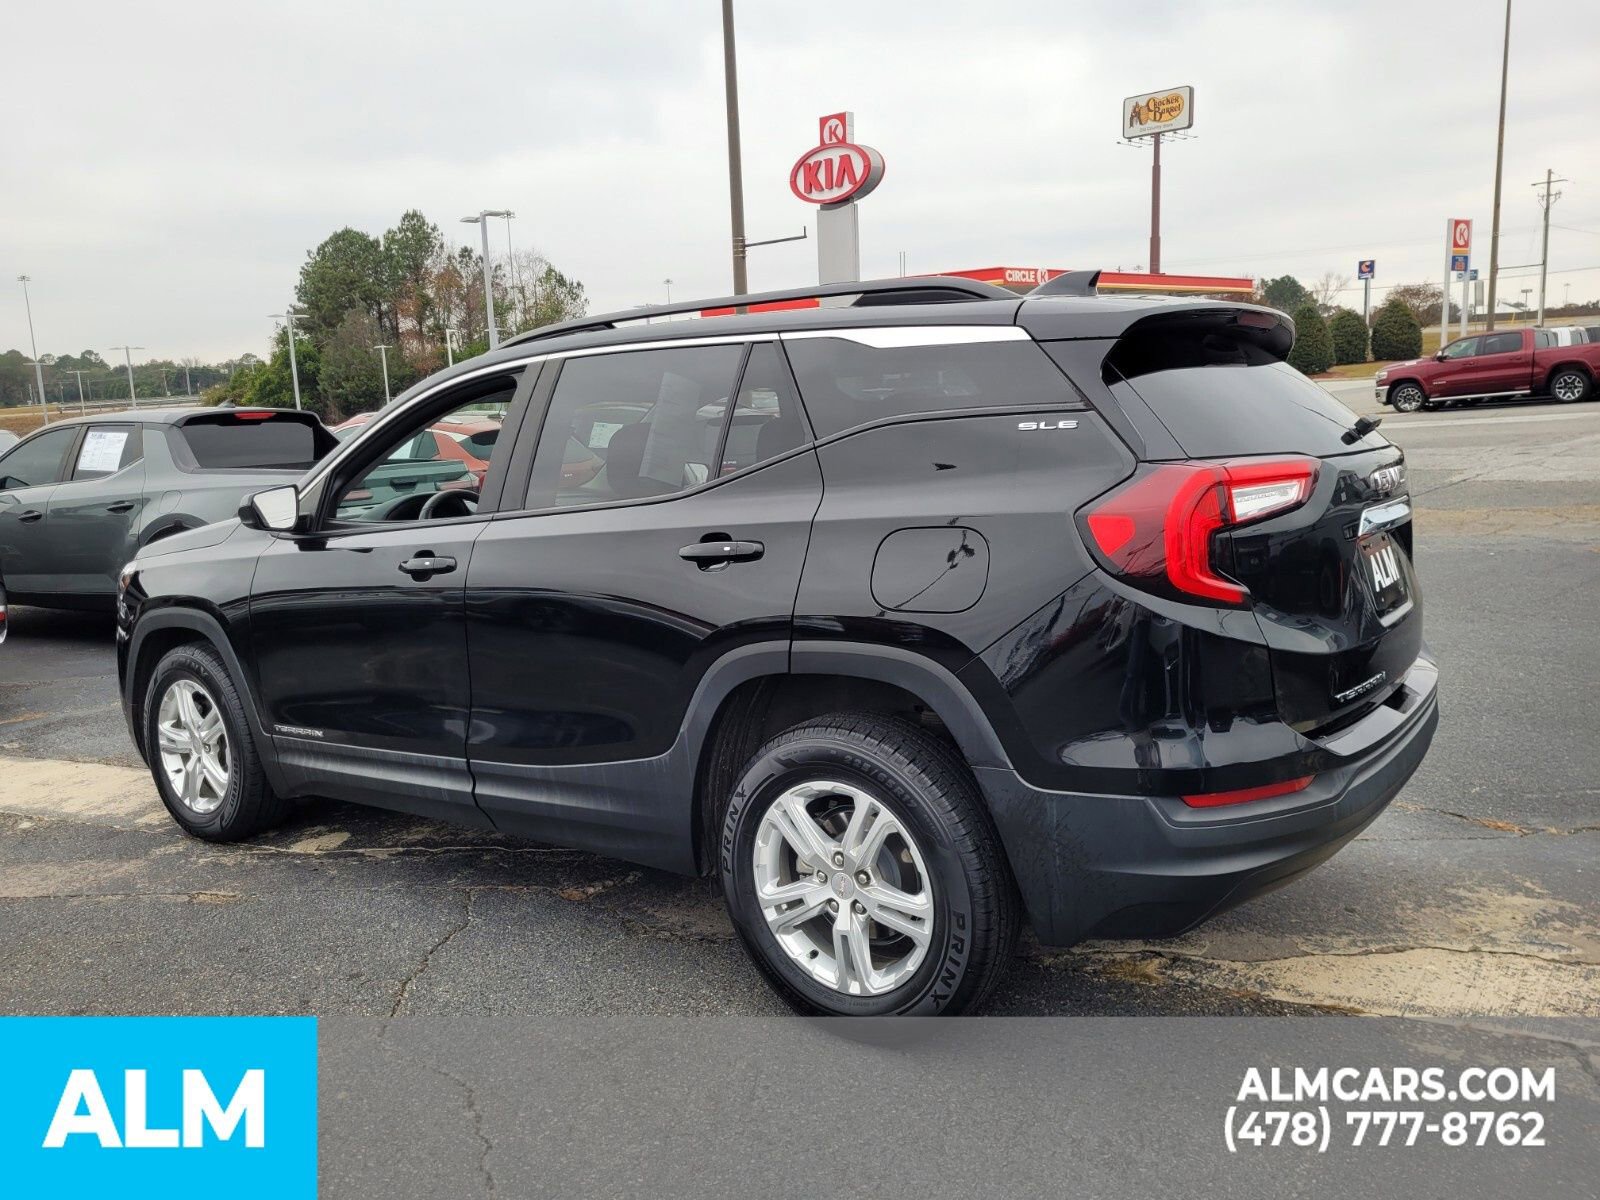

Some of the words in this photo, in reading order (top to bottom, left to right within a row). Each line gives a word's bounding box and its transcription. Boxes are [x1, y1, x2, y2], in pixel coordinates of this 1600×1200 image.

[1153, 103, 1181, 121] Barrel
[828, 123, 841, 142] K
[803, 154, 857, 194] KIA
[1005, 270, 1036, 282] CIRCLE
[1018, 420, 1078, 431] SLE
[1369, 545, 1400, 592] ALM
[722, 782, 747, 875] PRINX
[931, 910, 966, 1010] PRINX
